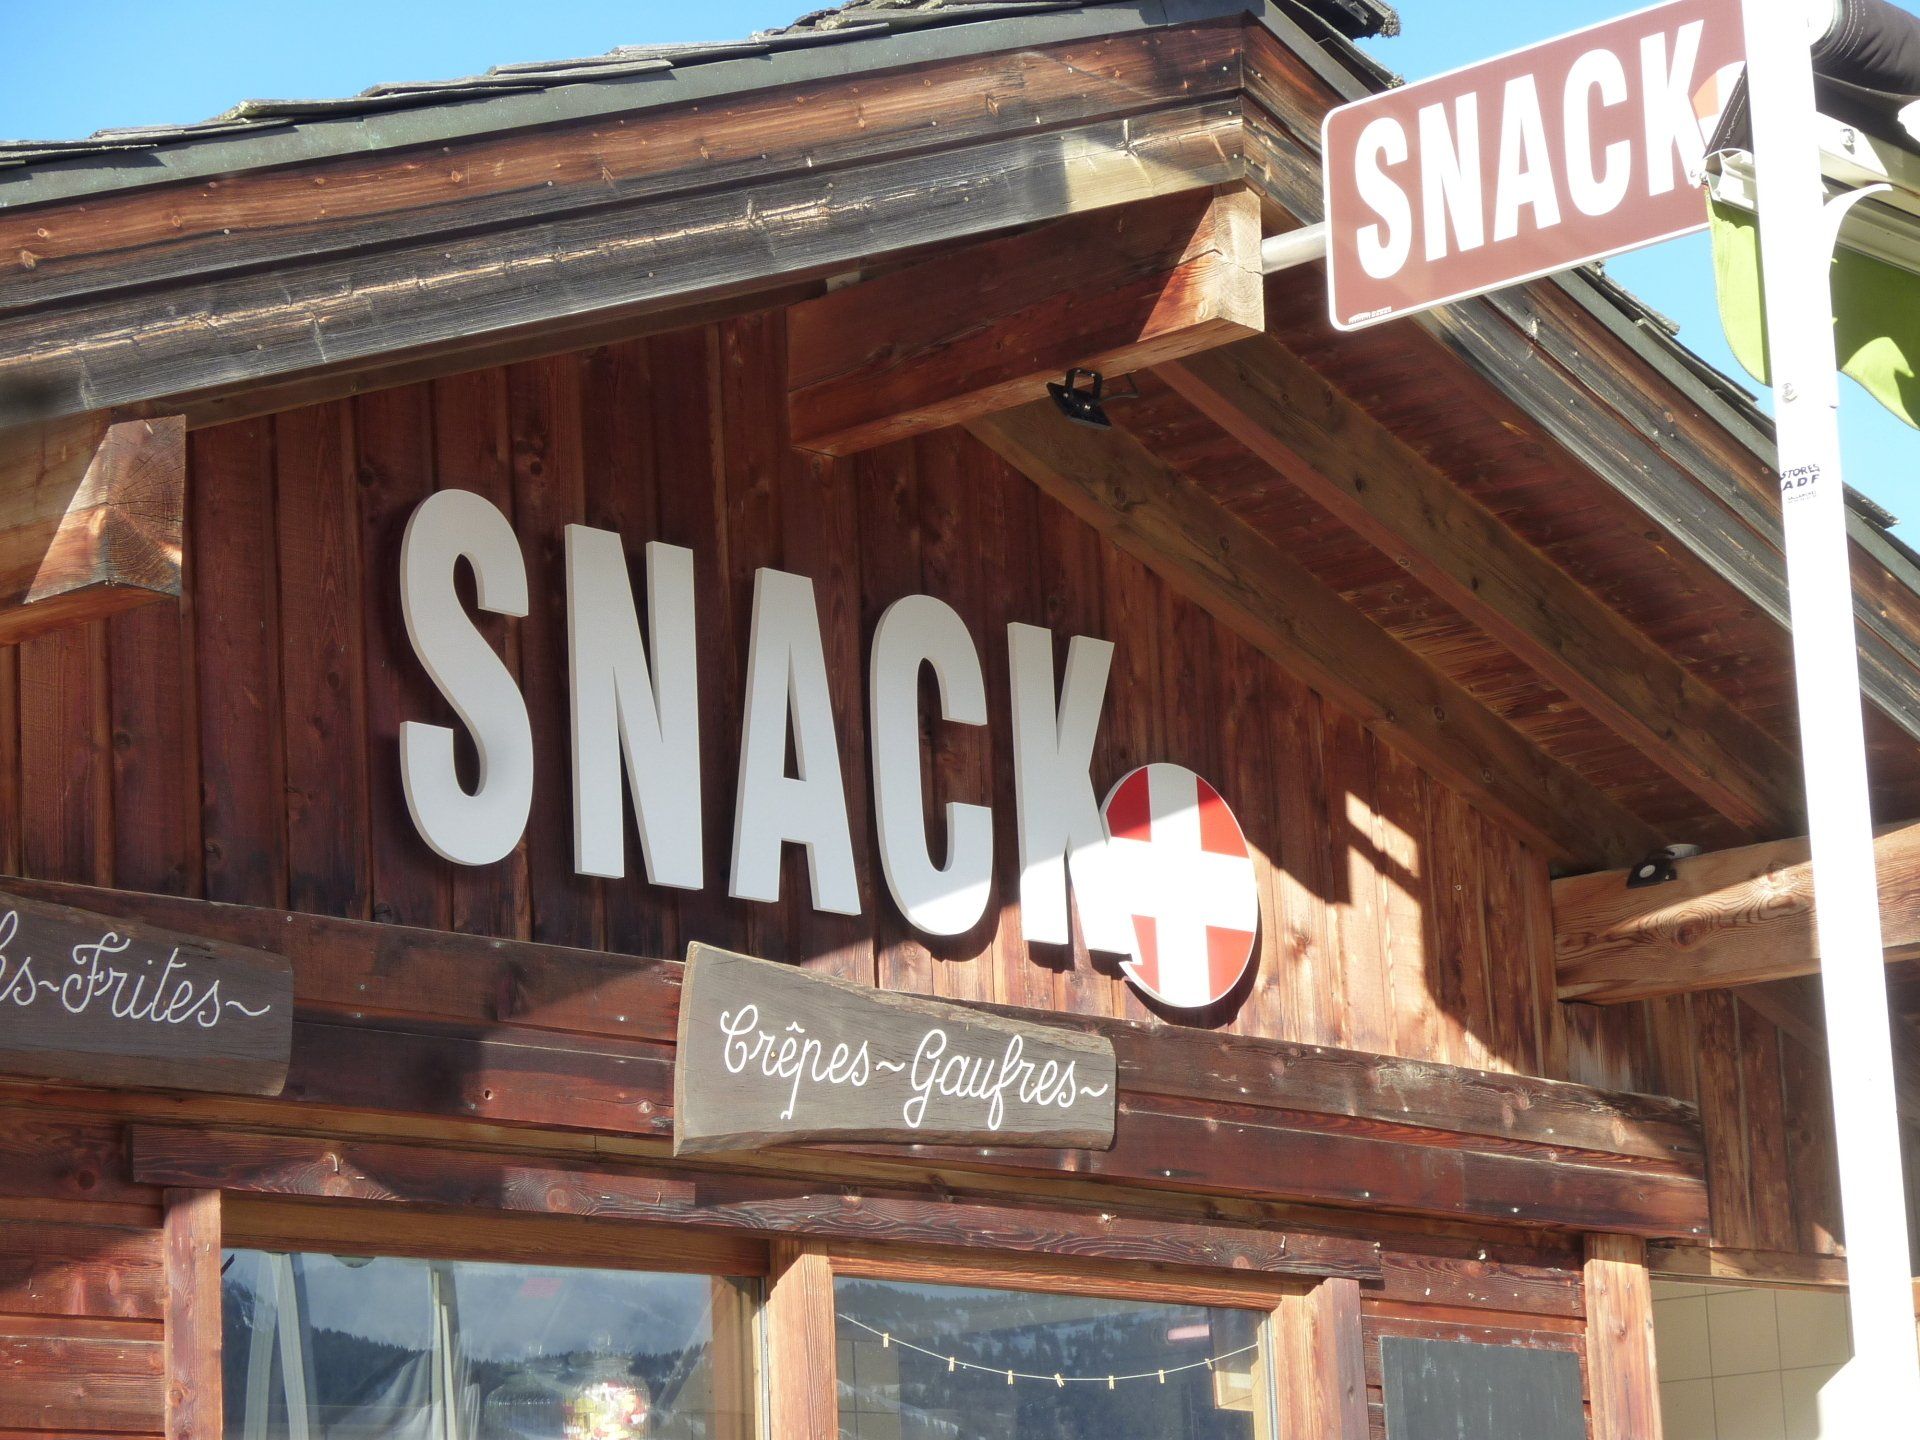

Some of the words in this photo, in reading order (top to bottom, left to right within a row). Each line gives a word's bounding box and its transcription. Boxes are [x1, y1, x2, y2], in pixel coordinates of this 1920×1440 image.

[1354, 19, 1708, 280] SNACK
[1780, 463, 1820, 481] STORES
[400, 488, 1132, 956] SNACK
